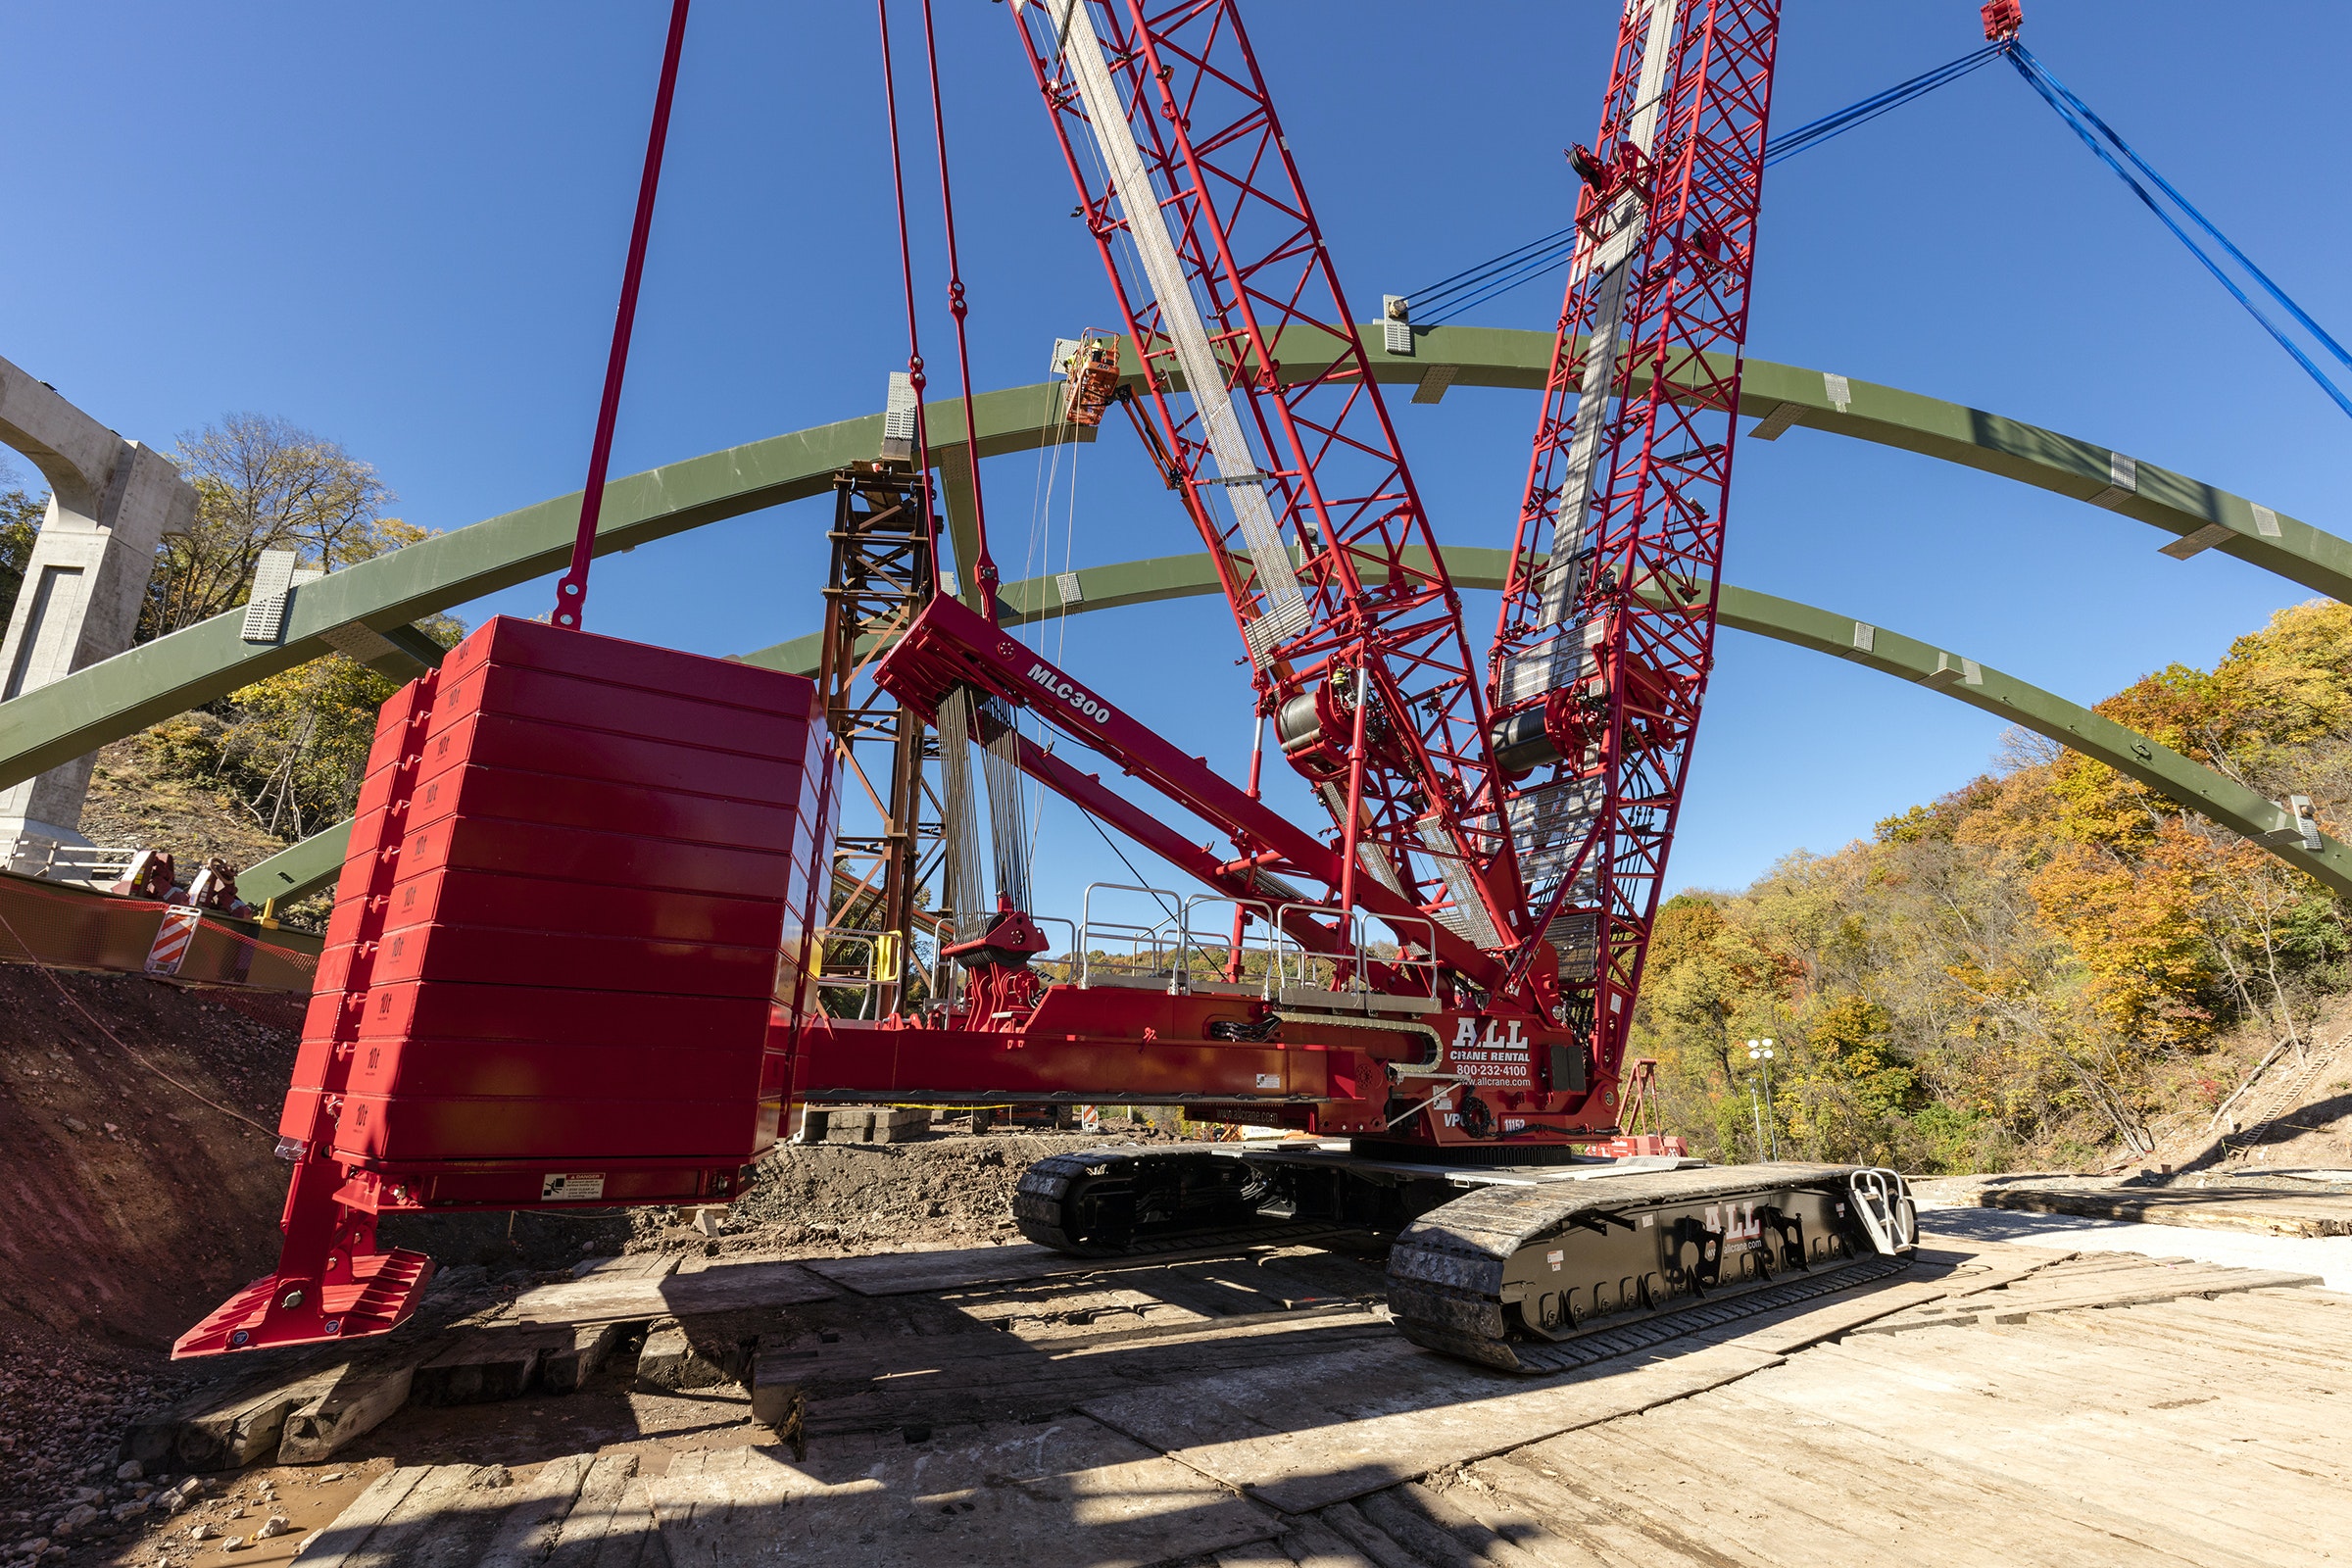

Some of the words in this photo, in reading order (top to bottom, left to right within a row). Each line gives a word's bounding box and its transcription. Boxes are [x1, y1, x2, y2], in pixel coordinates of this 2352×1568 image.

[1026, 663, 1110, 723] MLC300
[1451, 1017, 1529, 1050] ALL
[1450, 1051, 1488, 1061] CRANE
[1491, 1052, 1531, 1062] RENTAL
[1456, 1077, 1531, 1087] ww.allcrane.com
[1705, 1201, 1761, 1241] ALL
